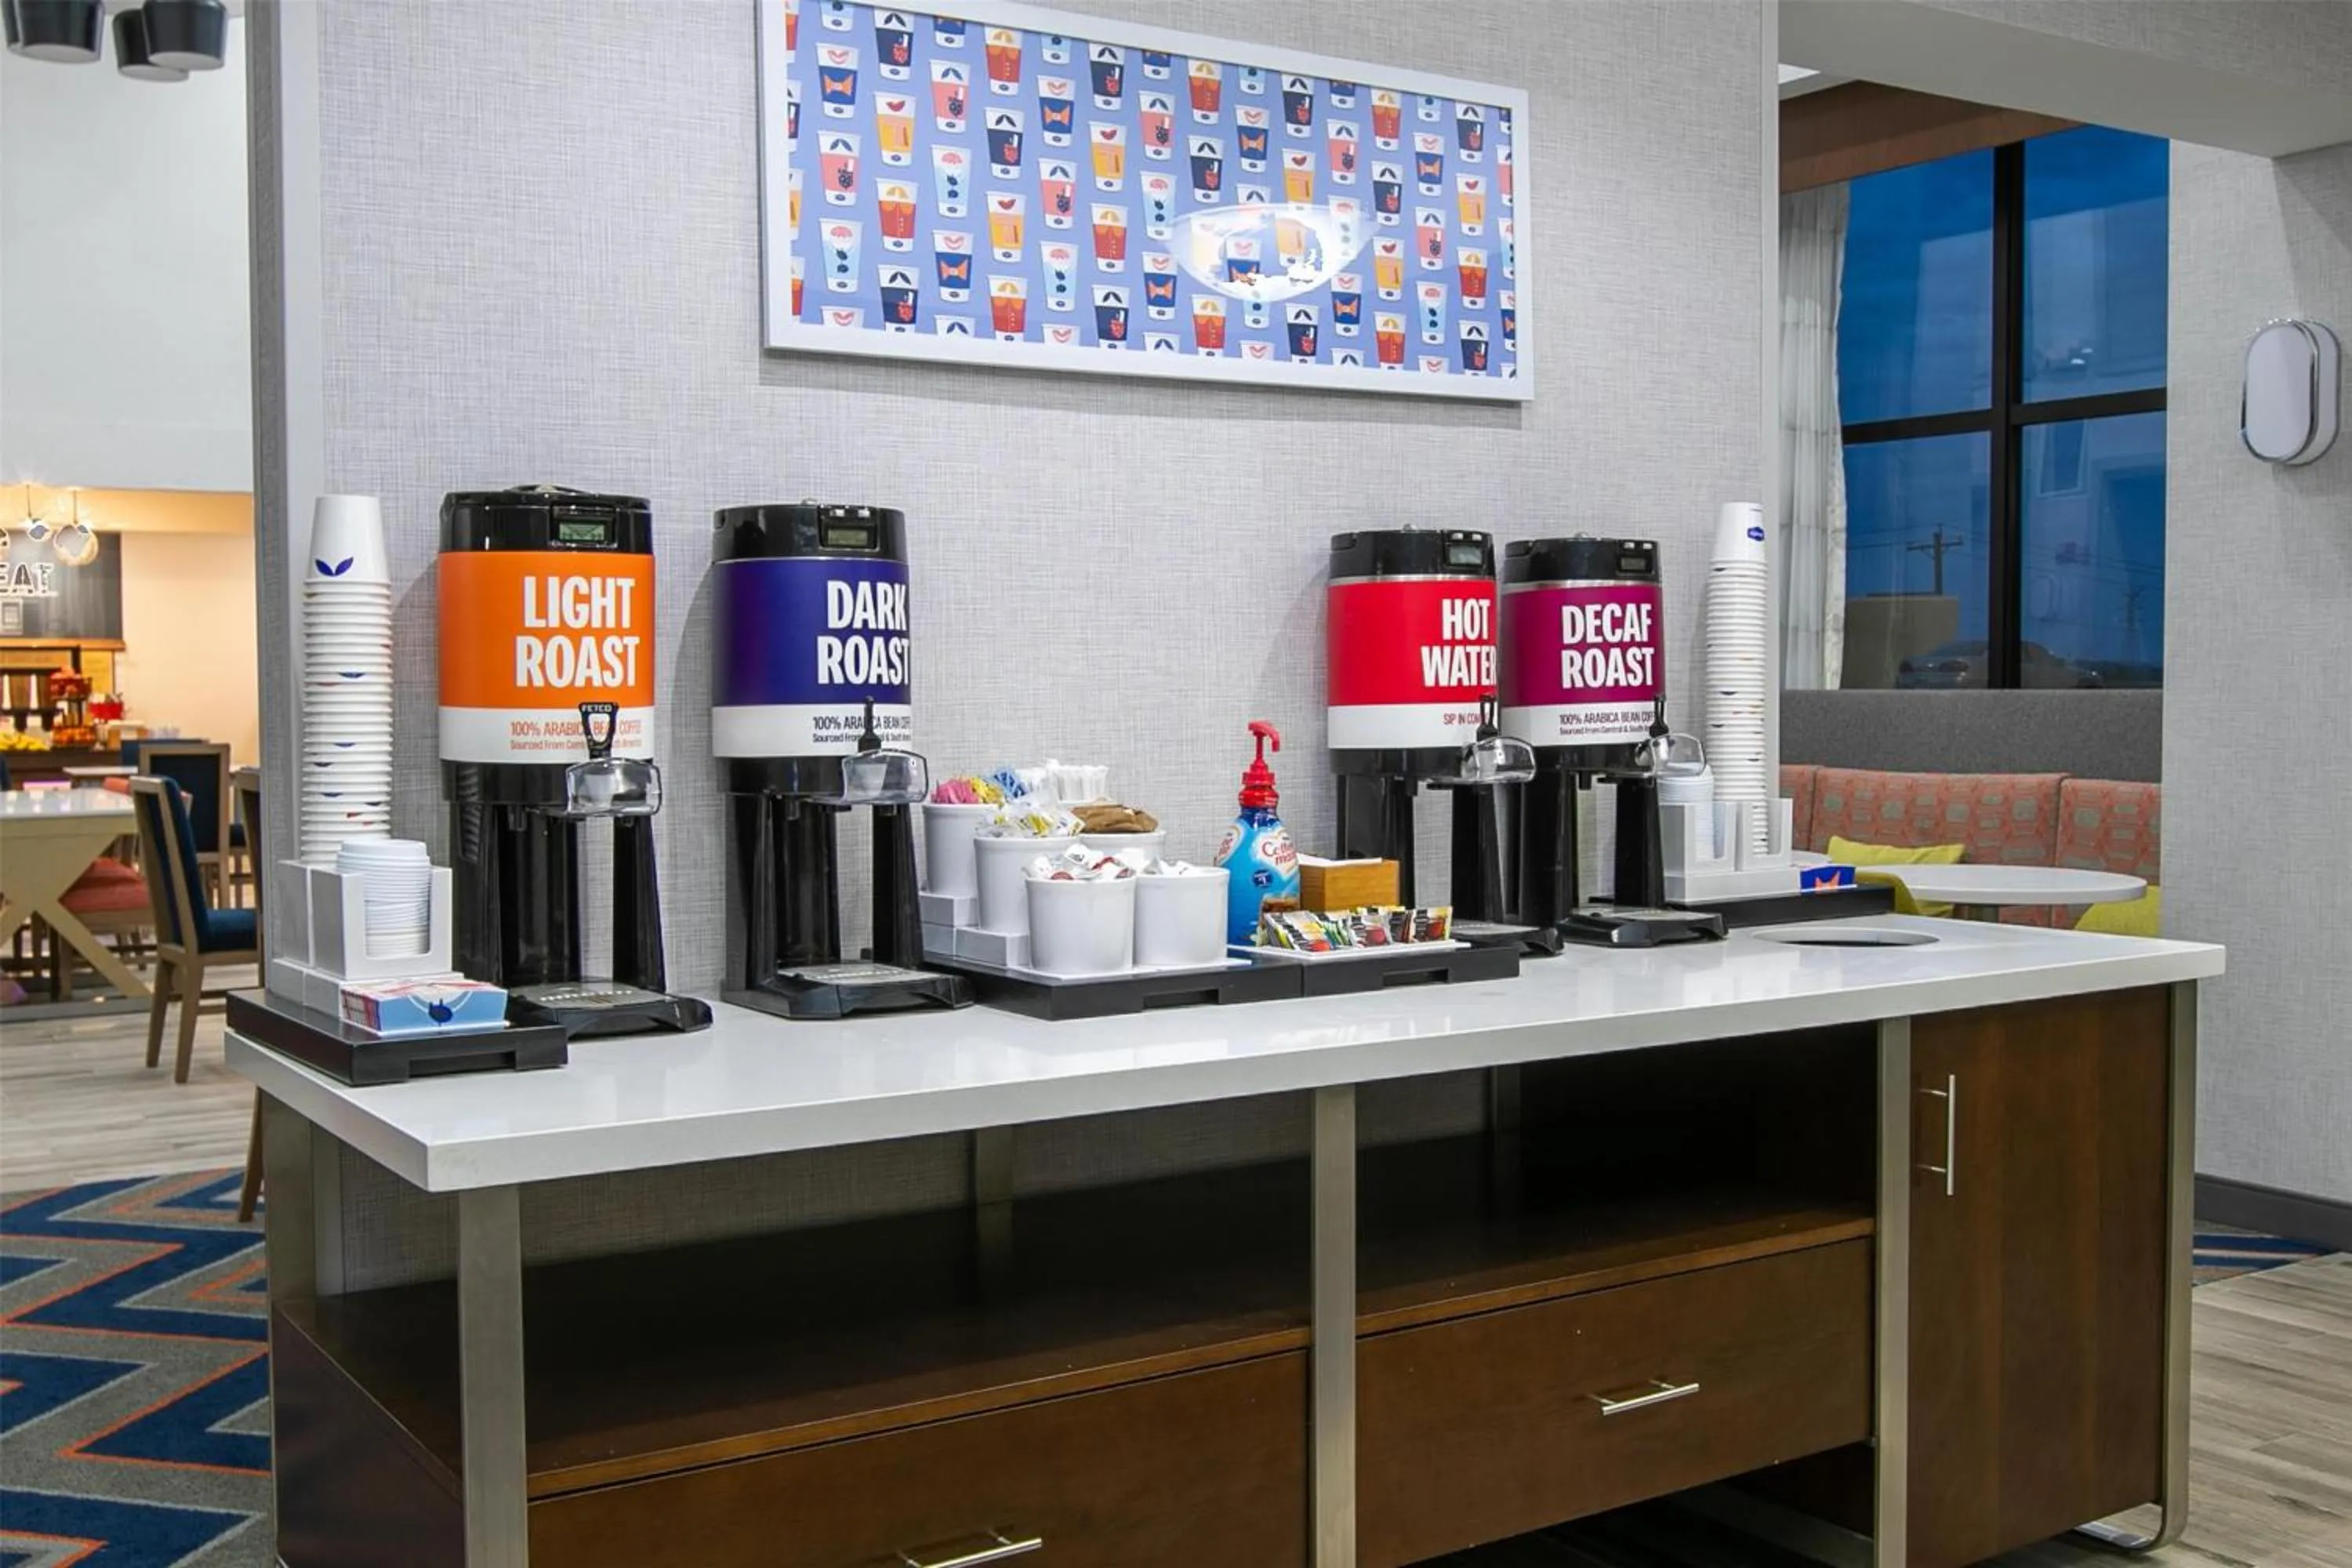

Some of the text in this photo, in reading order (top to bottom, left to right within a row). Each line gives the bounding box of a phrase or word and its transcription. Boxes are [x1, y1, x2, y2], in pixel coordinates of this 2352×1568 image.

[524, 576, 636, 629] LIGHT
[827, 580, 907, 631] DARK
[1443, 598, 1491, 640] HOT
[1562, 603, 1652, 644] DECAF
[515, 635, 641, 688] ROAST
[817, 636, 909, 685] ROAST
[1421, 645, 1497, 687] WATER
[1561, 647, 1655, 689] ROAST
[510, 720, 541, 736] 100%
[543, 720, 584, 735] ARABIC
[812, 716, 841, 730] 100%
[1559, 714, 1582, 725] 100%
[1584, 712, 1620, 724] ARABICA
